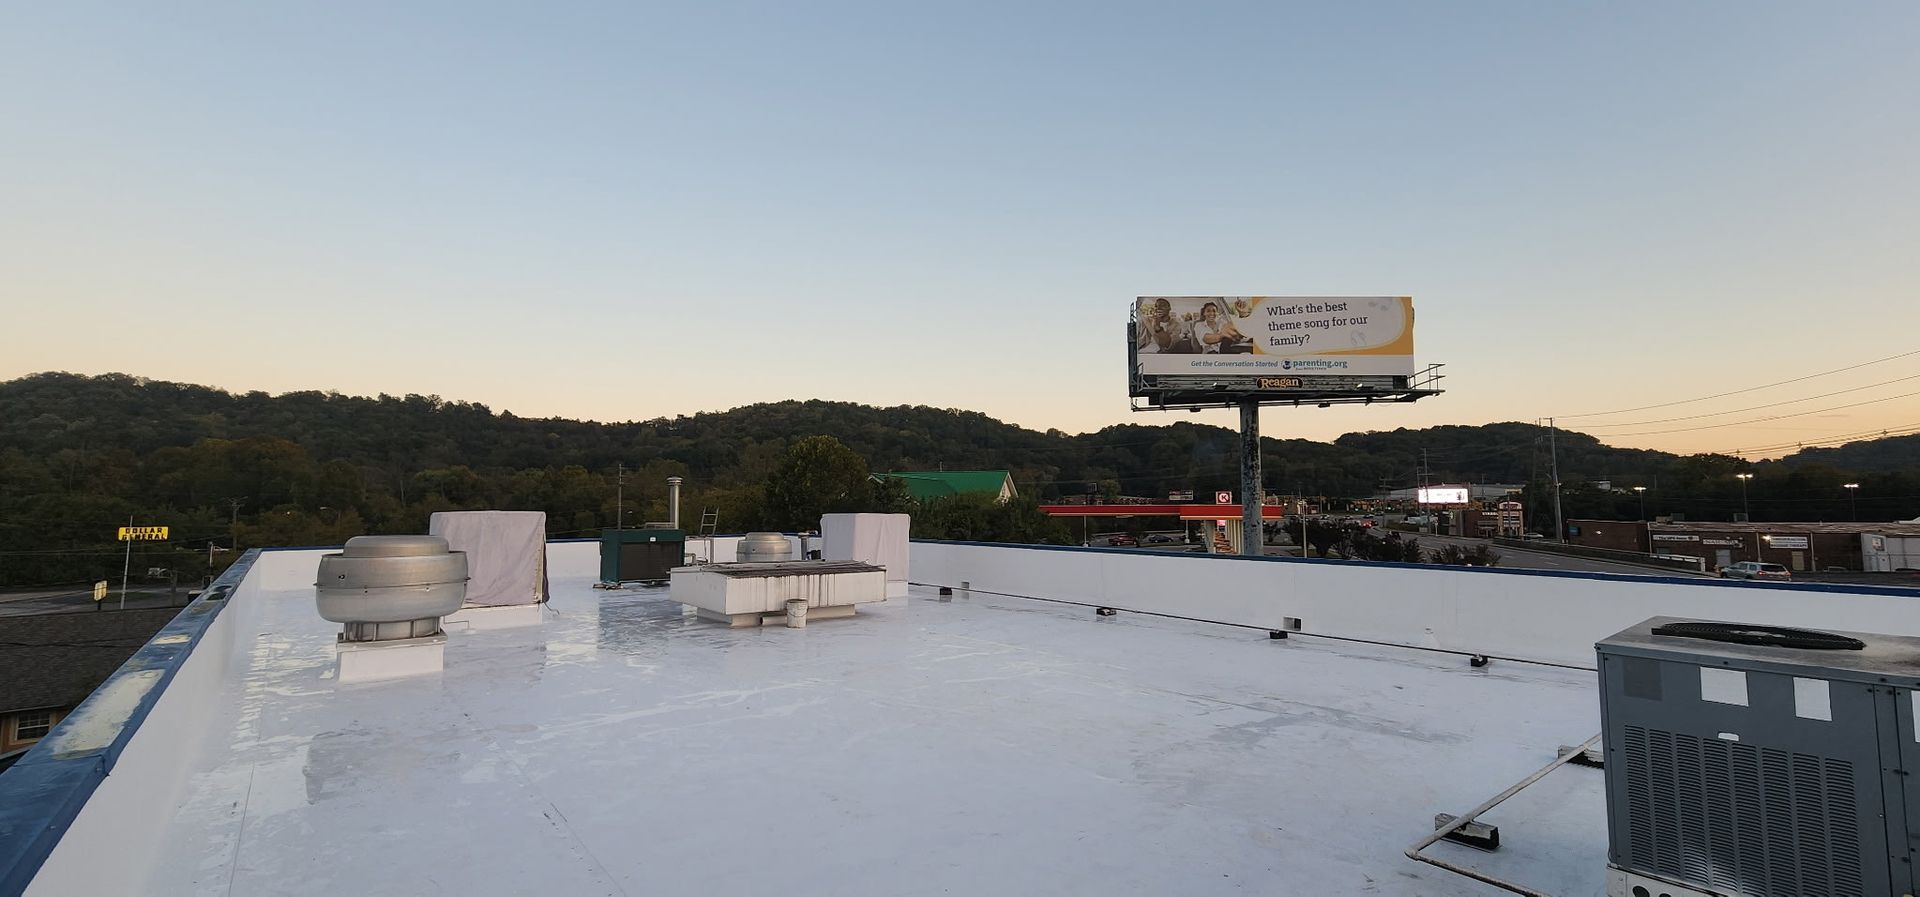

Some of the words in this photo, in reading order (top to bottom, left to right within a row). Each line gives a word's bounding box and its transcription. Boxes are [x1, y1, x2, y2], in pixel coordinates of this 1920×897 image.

[1267, 305, 1303, 316] What's
[1305, 303, 1323, 313] the
[1325, 302, 1347, 312] best
[1268, 321, 1302, 331] theme
[1304, 319, 1330, 329] song
[1332, 317, 1347, 327] for
[1350, 316, 1368, 325] our
[1270, 334, 1310, 346] family?
[1293, 359, 1348, 369] parenting.org
[1260, 377, 1300, 389] Reagan
